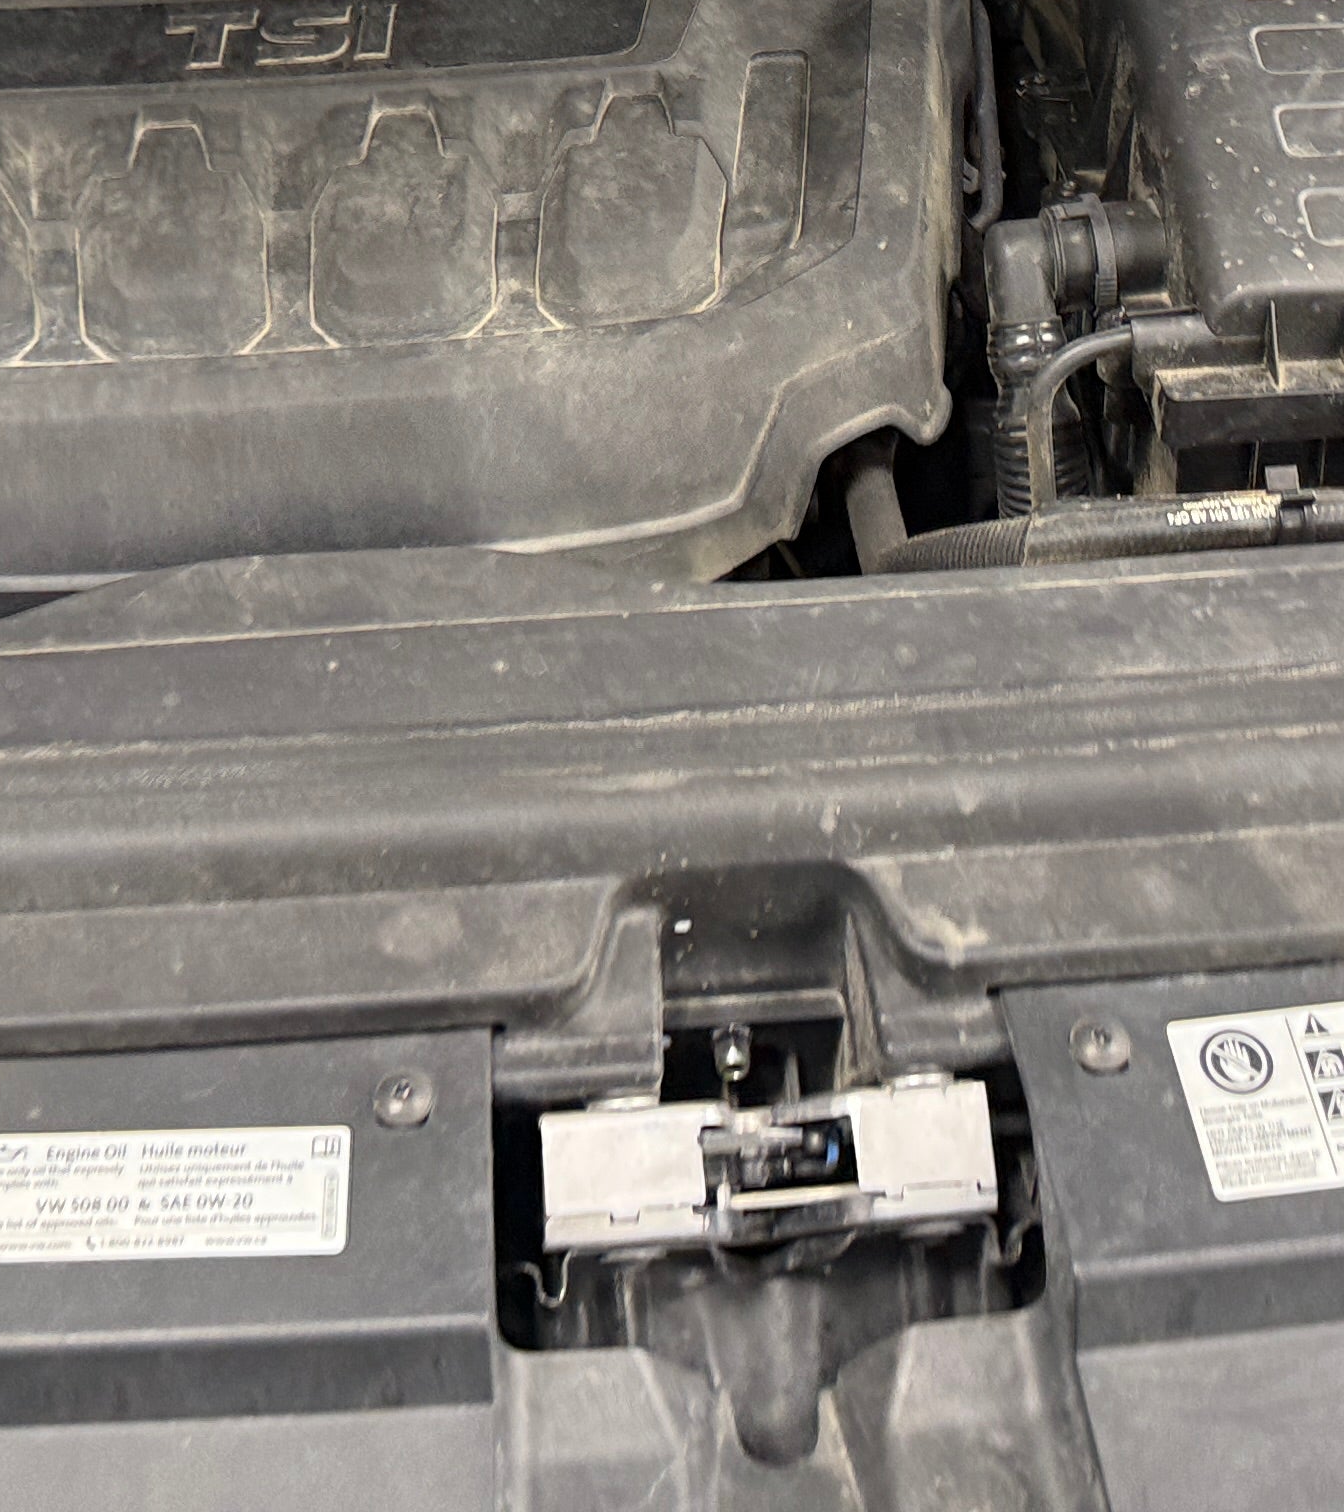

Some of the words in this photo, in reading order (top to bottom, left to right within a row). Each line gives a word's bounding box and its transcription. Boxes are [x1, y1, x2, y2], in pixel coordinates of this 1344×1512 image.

[164, 2, 400, 71] TSI
[46, 1145, 100, 1163] Engine
[104, 1143, 127, 1160] Oil
[141, 1143, 183, 1158] Huile
[188, 1143, 248, 1158] moteur
[36, 1197, 66, 1214] VW
[106, 1196, 129, 1212] 00
[160, 1193, 192, 1211] SAE
